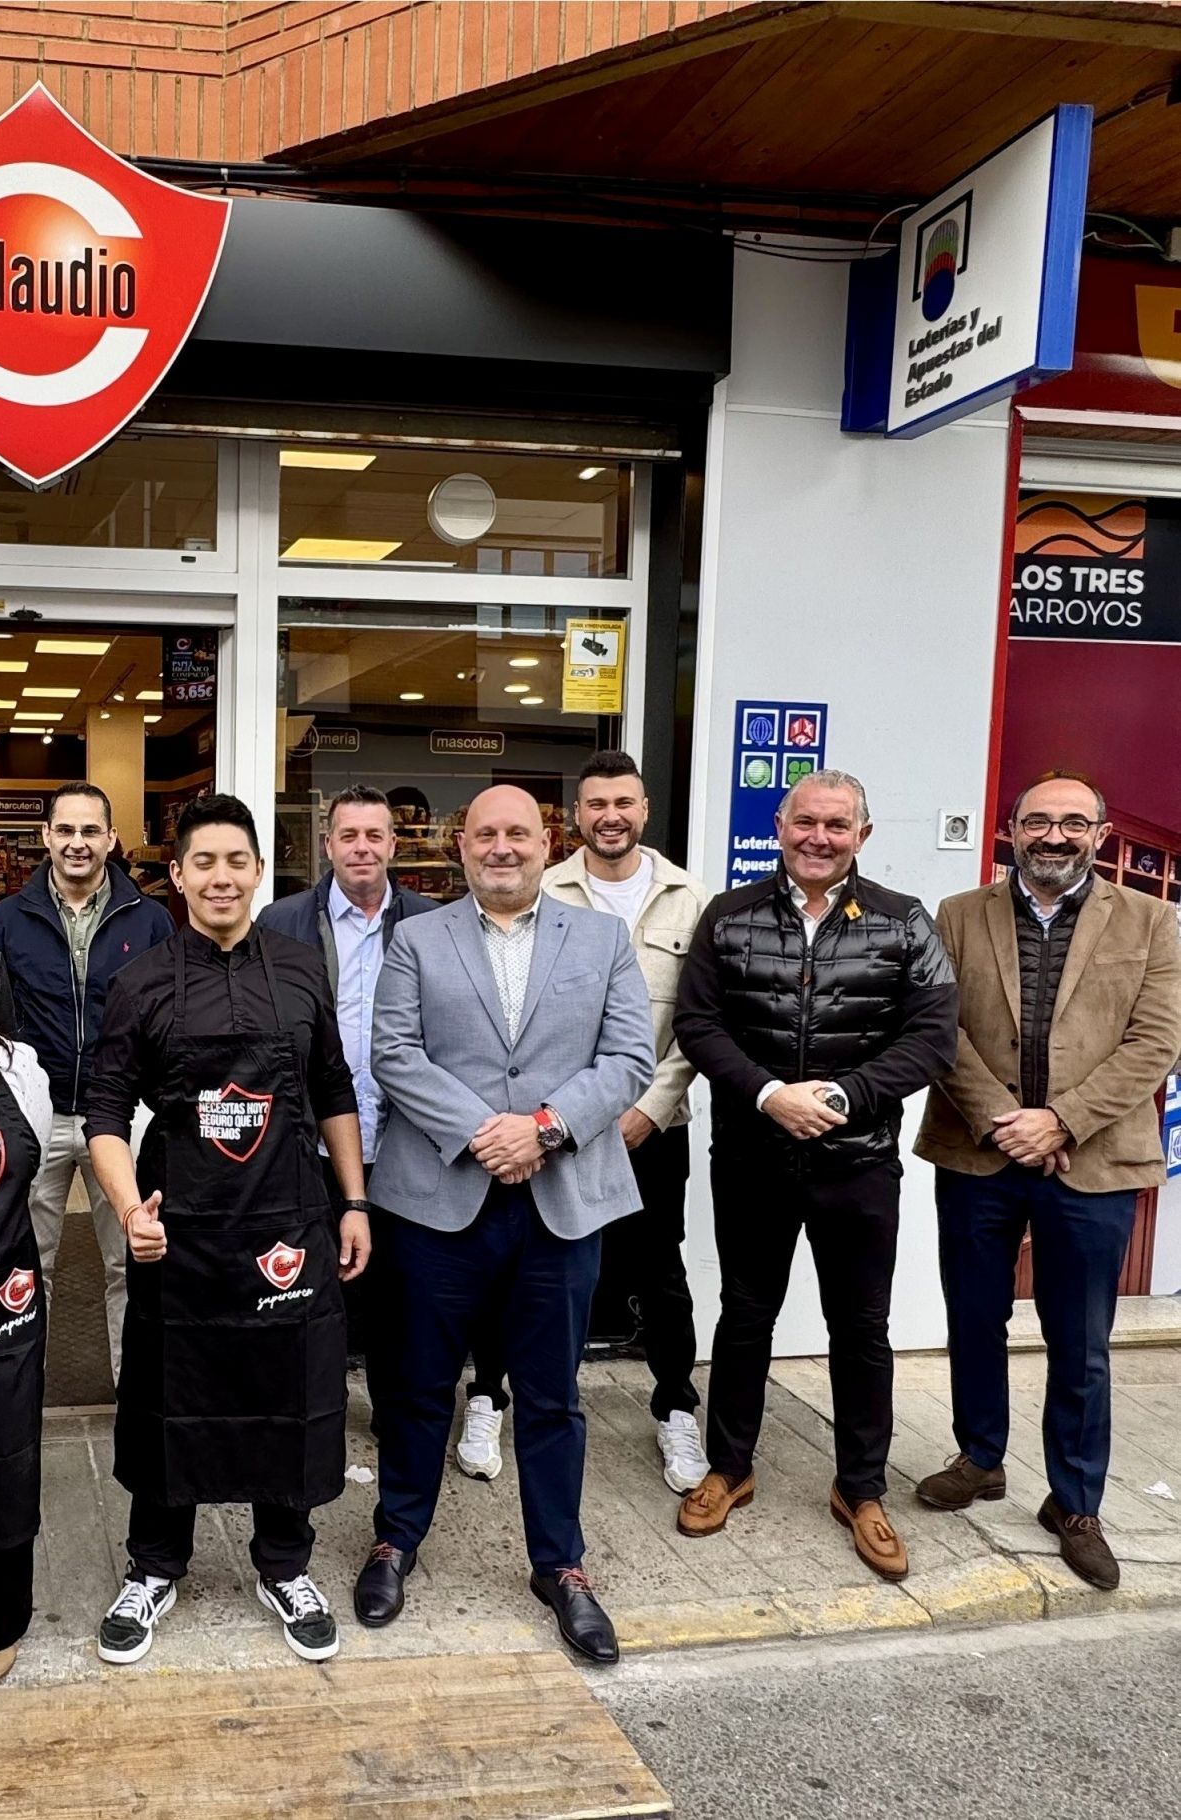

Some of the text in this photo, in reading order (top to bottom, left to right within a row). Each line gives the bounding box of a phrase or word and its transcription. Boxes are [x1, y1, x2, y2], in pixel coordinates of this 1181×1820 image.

[908, 307, 981, 359] Loterías y
[907, 316, 1002, 383] Apuestas del
[905, 371, 953, 408] Estado
[1011, 564, 1145, 595] OS TRES
[1009, 597, 1142, 627] ARROYOS
[176, 684, 213, 700] 3,65€
[436, 735, 499, 750] mascotas
[734, 836, 783, 851] Lotería
[732, 857, 778, 874] Apuest
[199, 1102, 269, 1114] NECESITAS HOY?
[199, 1113, 264, 1128] SEGURO QUE LO
[199, 1126, 241, 1140] TENEMOS
